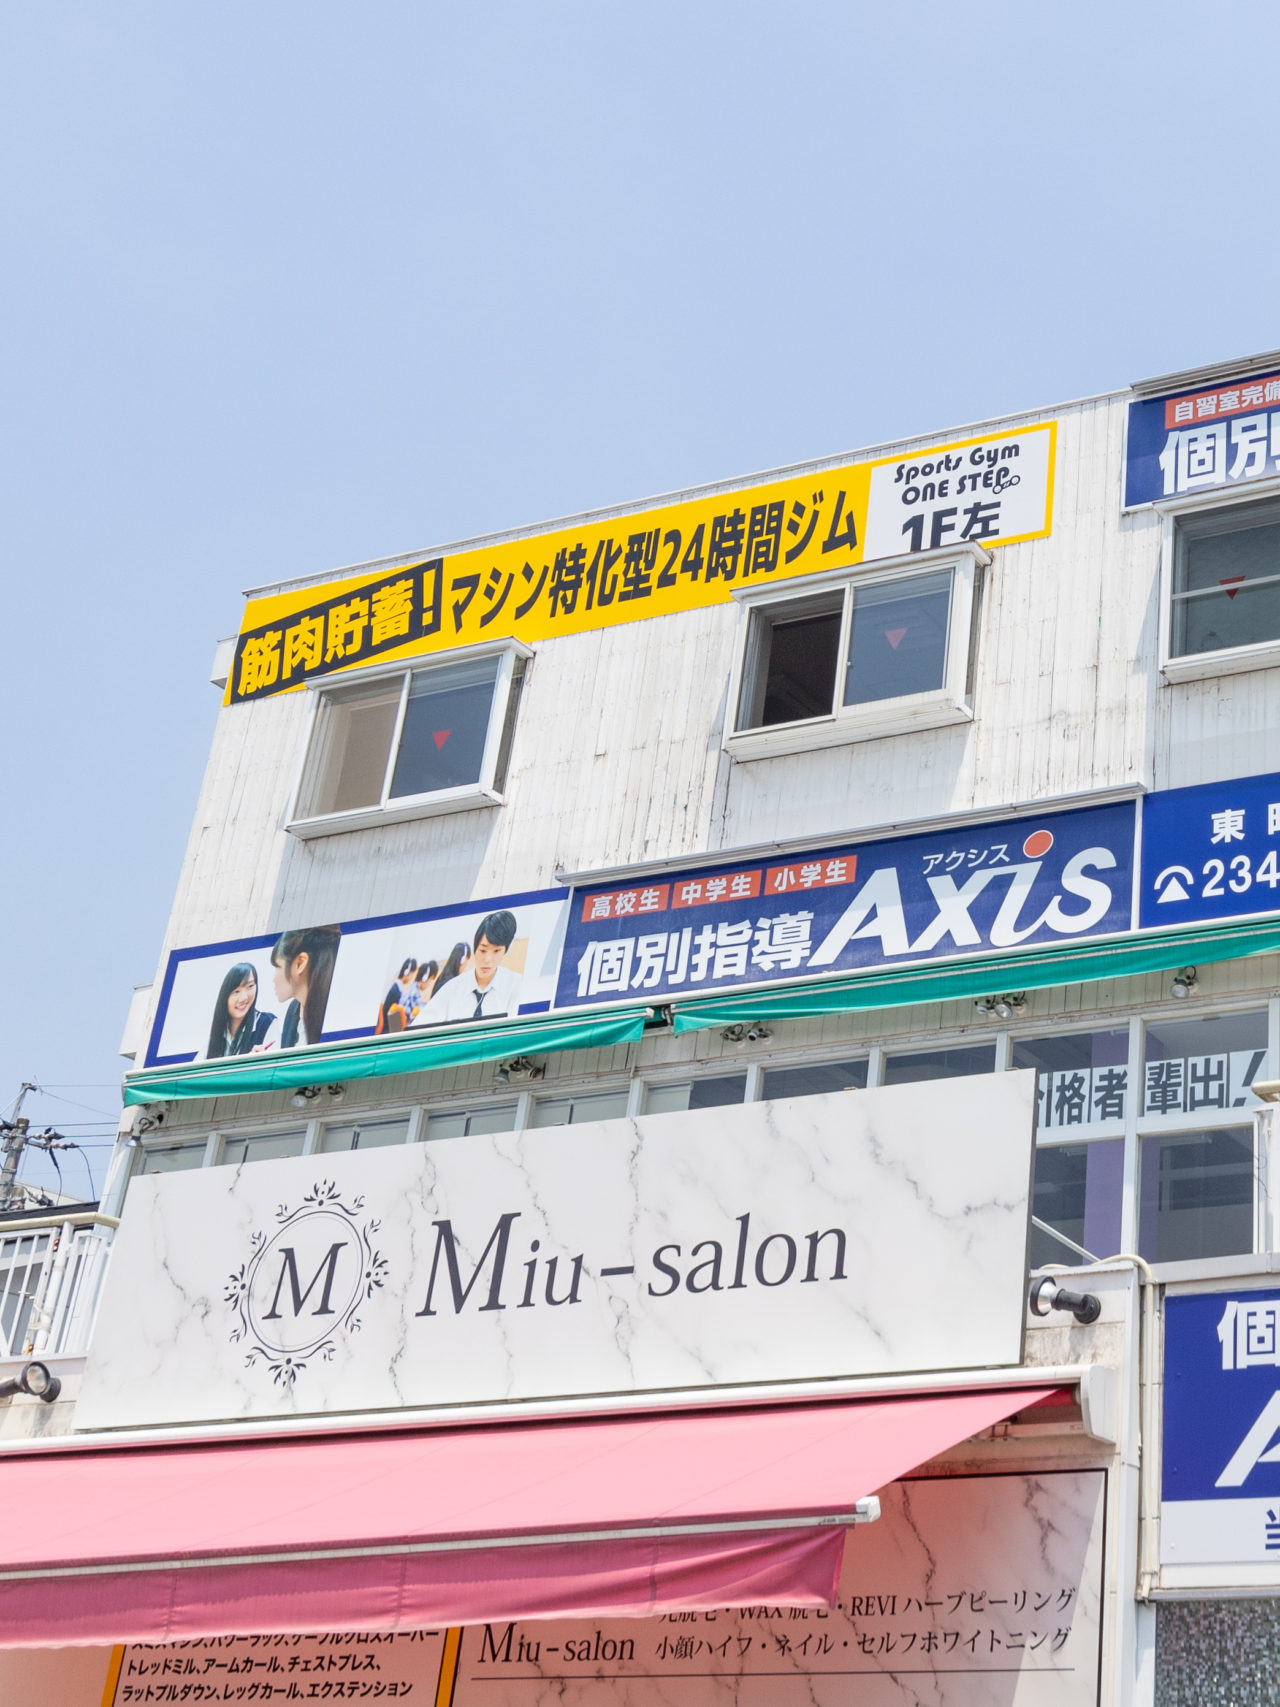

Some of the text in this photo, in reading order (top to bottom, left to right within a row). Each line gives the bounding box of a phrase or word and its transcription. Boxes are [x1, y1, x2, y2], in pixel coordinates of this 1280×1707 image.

[893, 443, 1020, 485] Sports Gym
[901, 466, 1011, 506] ONE STEP
[901, 501, 1001, 552] 1F左
[923, 843, 1010, 875] アクシス
[590, 859, 848, 919] 高校生 中学生 小学生
[807, 829, 1117, 967] Axis
[577, 911, 814, 997] 個別指導
[262, 1242, 348, 1320] M
[415, 1211, 848, 1317] Miu-salon
[477, 1622, 635, 1663] Miu-salon
